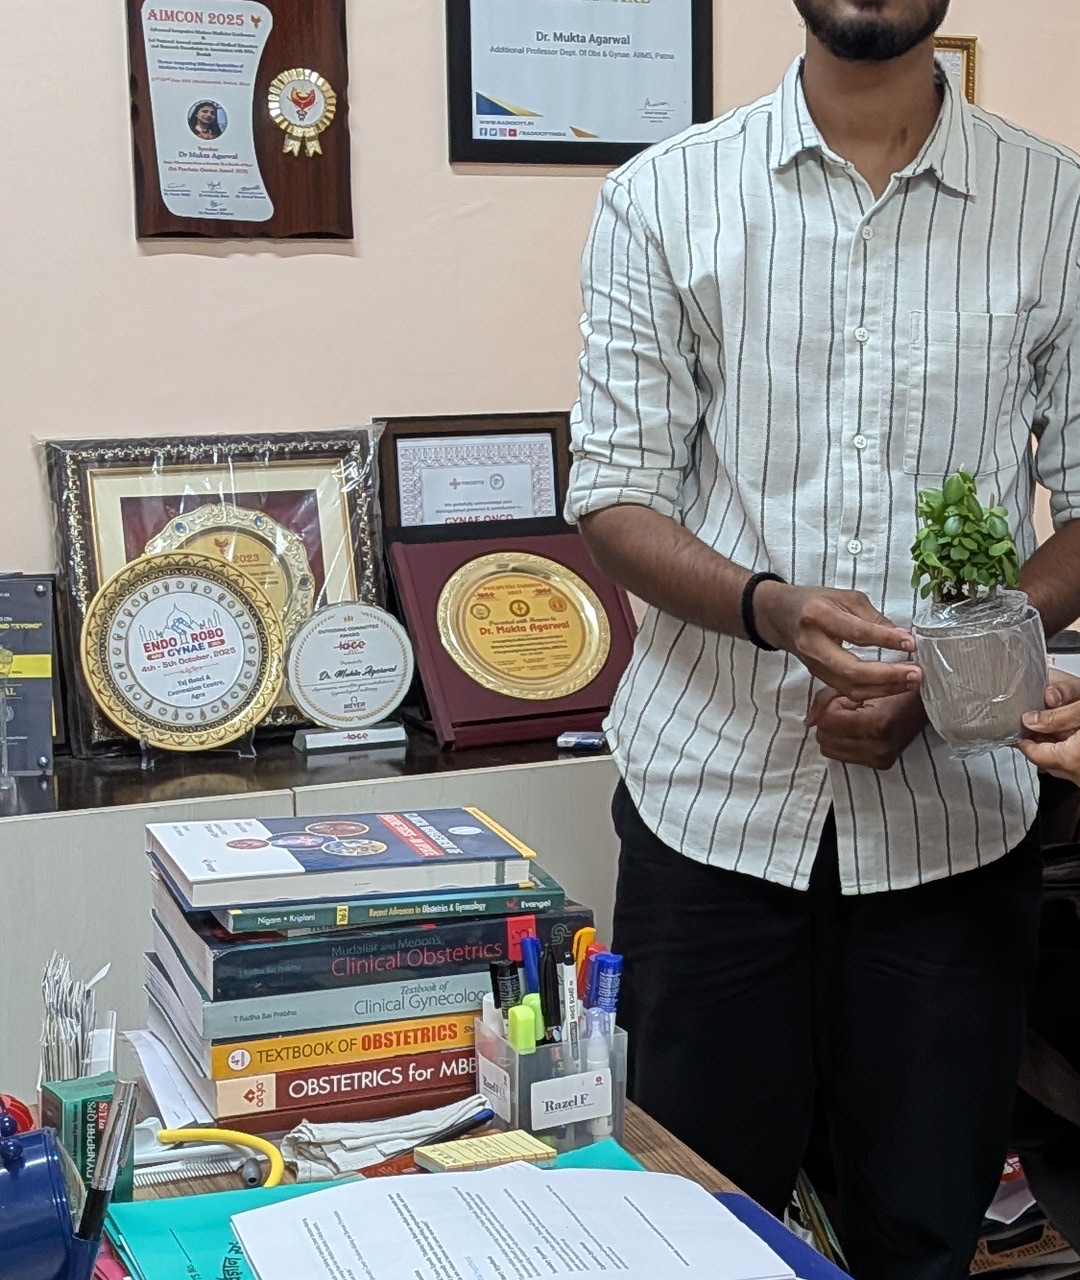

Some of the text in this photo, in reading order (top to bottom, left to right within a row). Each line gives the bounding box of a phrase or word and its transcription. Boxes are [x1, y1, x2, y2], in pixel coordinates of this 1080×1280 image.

[147, 9, 245, 26] AIMCON 2025
[536, 31, 631, 46] Dr. Mukta Agarwal
[490, 46, 525, 54] Additional
[526, 47, 558, 56] Professor
[560, 48, 576, 57] Dept.
[588, 49, 601, 57] Obs
[655, 52, 675, 60] Patna
[479, 627, 493, 635] Dr.
[530, 621, 570, 632] Agarwal
[143, 628, 224, 653] ENDO ROBO
[167, 643, 206, 657] GYNAE
[178, 653, 213, 665] October,
[213, 647, 236, 657] 2025
[369, 907, 389, 917] Recent
[390, 906, 415, 916] Advances
[421, 903, 448, 915] Obstetrics
[454, 901, 487, 914] Gynecology
[520, 899, 551, 910] Evangel
[380, 941, 397, 951] and
[331, 940, 503, 978] Clinical Obstetrics
[400, 981, 450, 995] Textbook of
[353, 994, 405, 1016] Clinical
[256, 1022, 458, 1064] TEXTBOOK OF OBSTETRICS
[288, 1057, 478, 1099] OBSTETRICS for MBB
[544, 1094, 578, 1113] Razel
[98, 1102, 109, 1130] PLUS
[86, 1101, 97, 1179] DYNAPAR QPS
